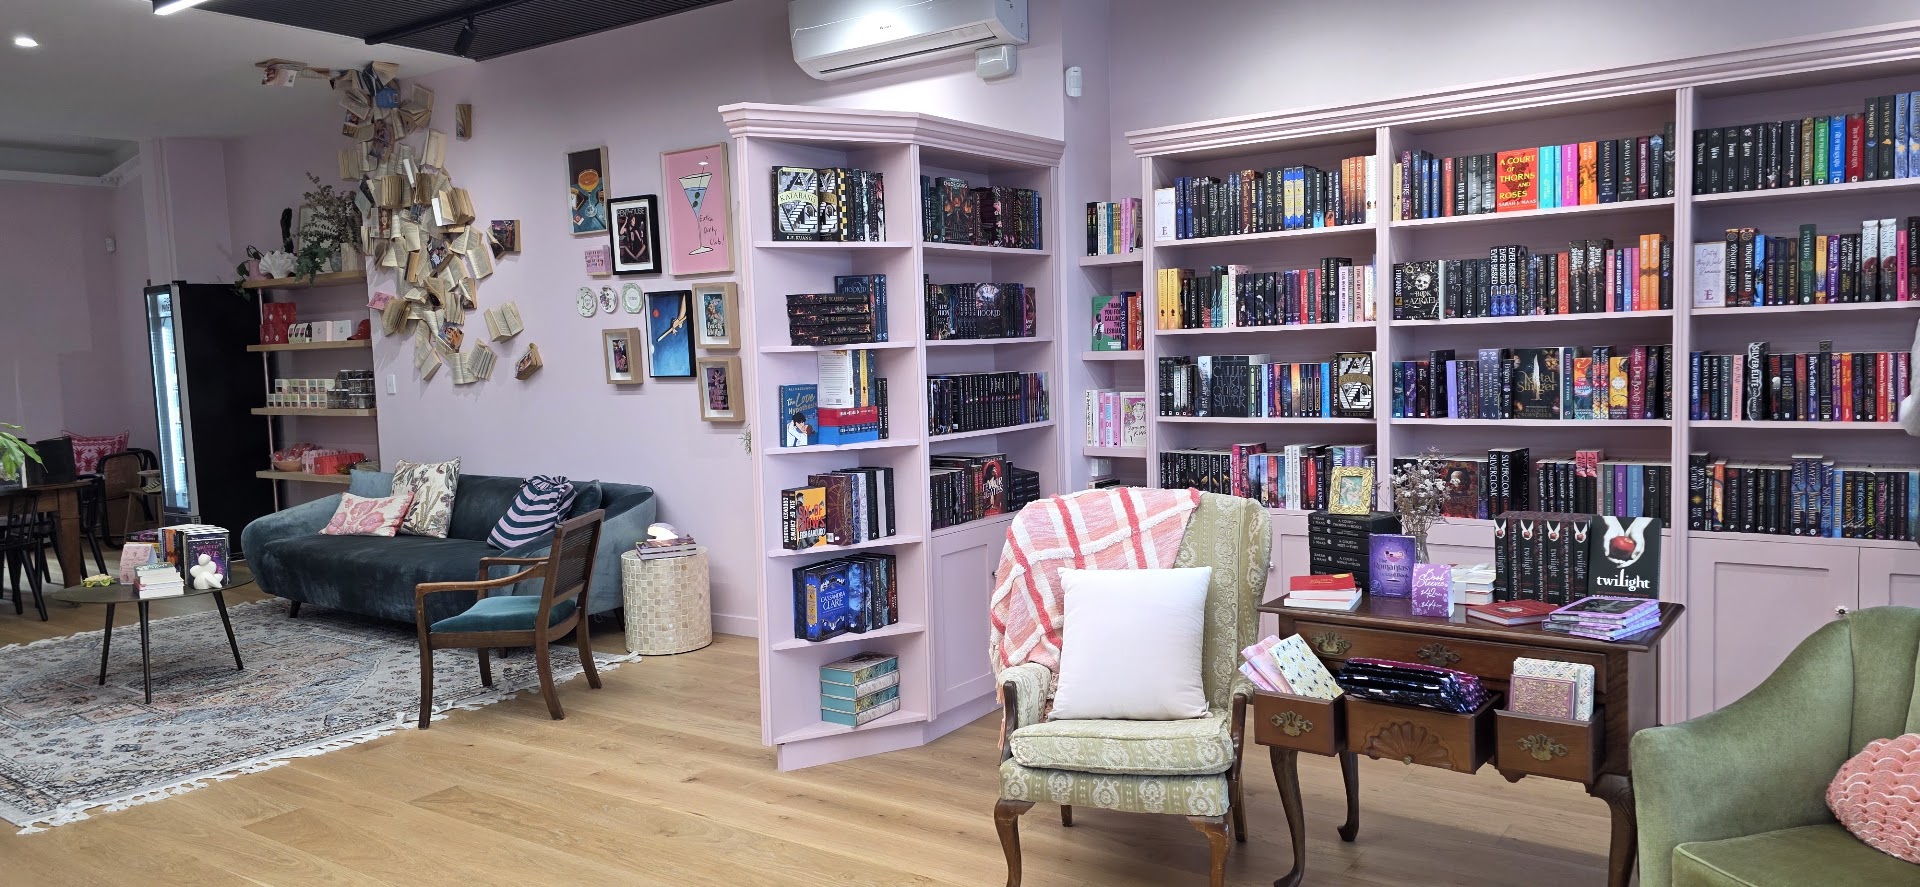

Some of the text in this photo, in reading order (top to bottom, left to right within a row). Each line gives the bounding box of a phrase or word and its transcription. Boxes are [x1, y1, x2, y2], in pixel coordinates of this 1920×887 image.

[1508, 155, 1536, 164] COURT
[1500, 173, 1535, 183] THORNS
[780, 193, 817, 204] KATABASIS
[1499, 190, 1528, 199] ROSES
[704, 226, 717, 236] Dirty
[710, 234, 724, 245] Club!
[1704, 289, 1714, 300] E
[1213, 365, 1247, 377] CALLIE
[1216, 376, 1240, 387] HART
[1517, 380, 1557, 392] Slinger
[1213, 385, 1246, 397] QUICK
[1213, 396, 1246, 408] SILVER
[788, 402, 818, 415] Hypothesis
[798, 504, 823, 516] SIX OF
[797, 518, 825, 531] CROWS
[808, 528, 826, 537] BARDUGO
[1374, 563, 1411, 572] Romantasy
[1426, 569, 1445, 580] Book
[1416, 574, 1446, 587] Sleeves
[1597, 569, 1650, 592] twilight
[820, 591, 845, 603] CASSANDRA
[822, 600, 843, 610] CLARE
